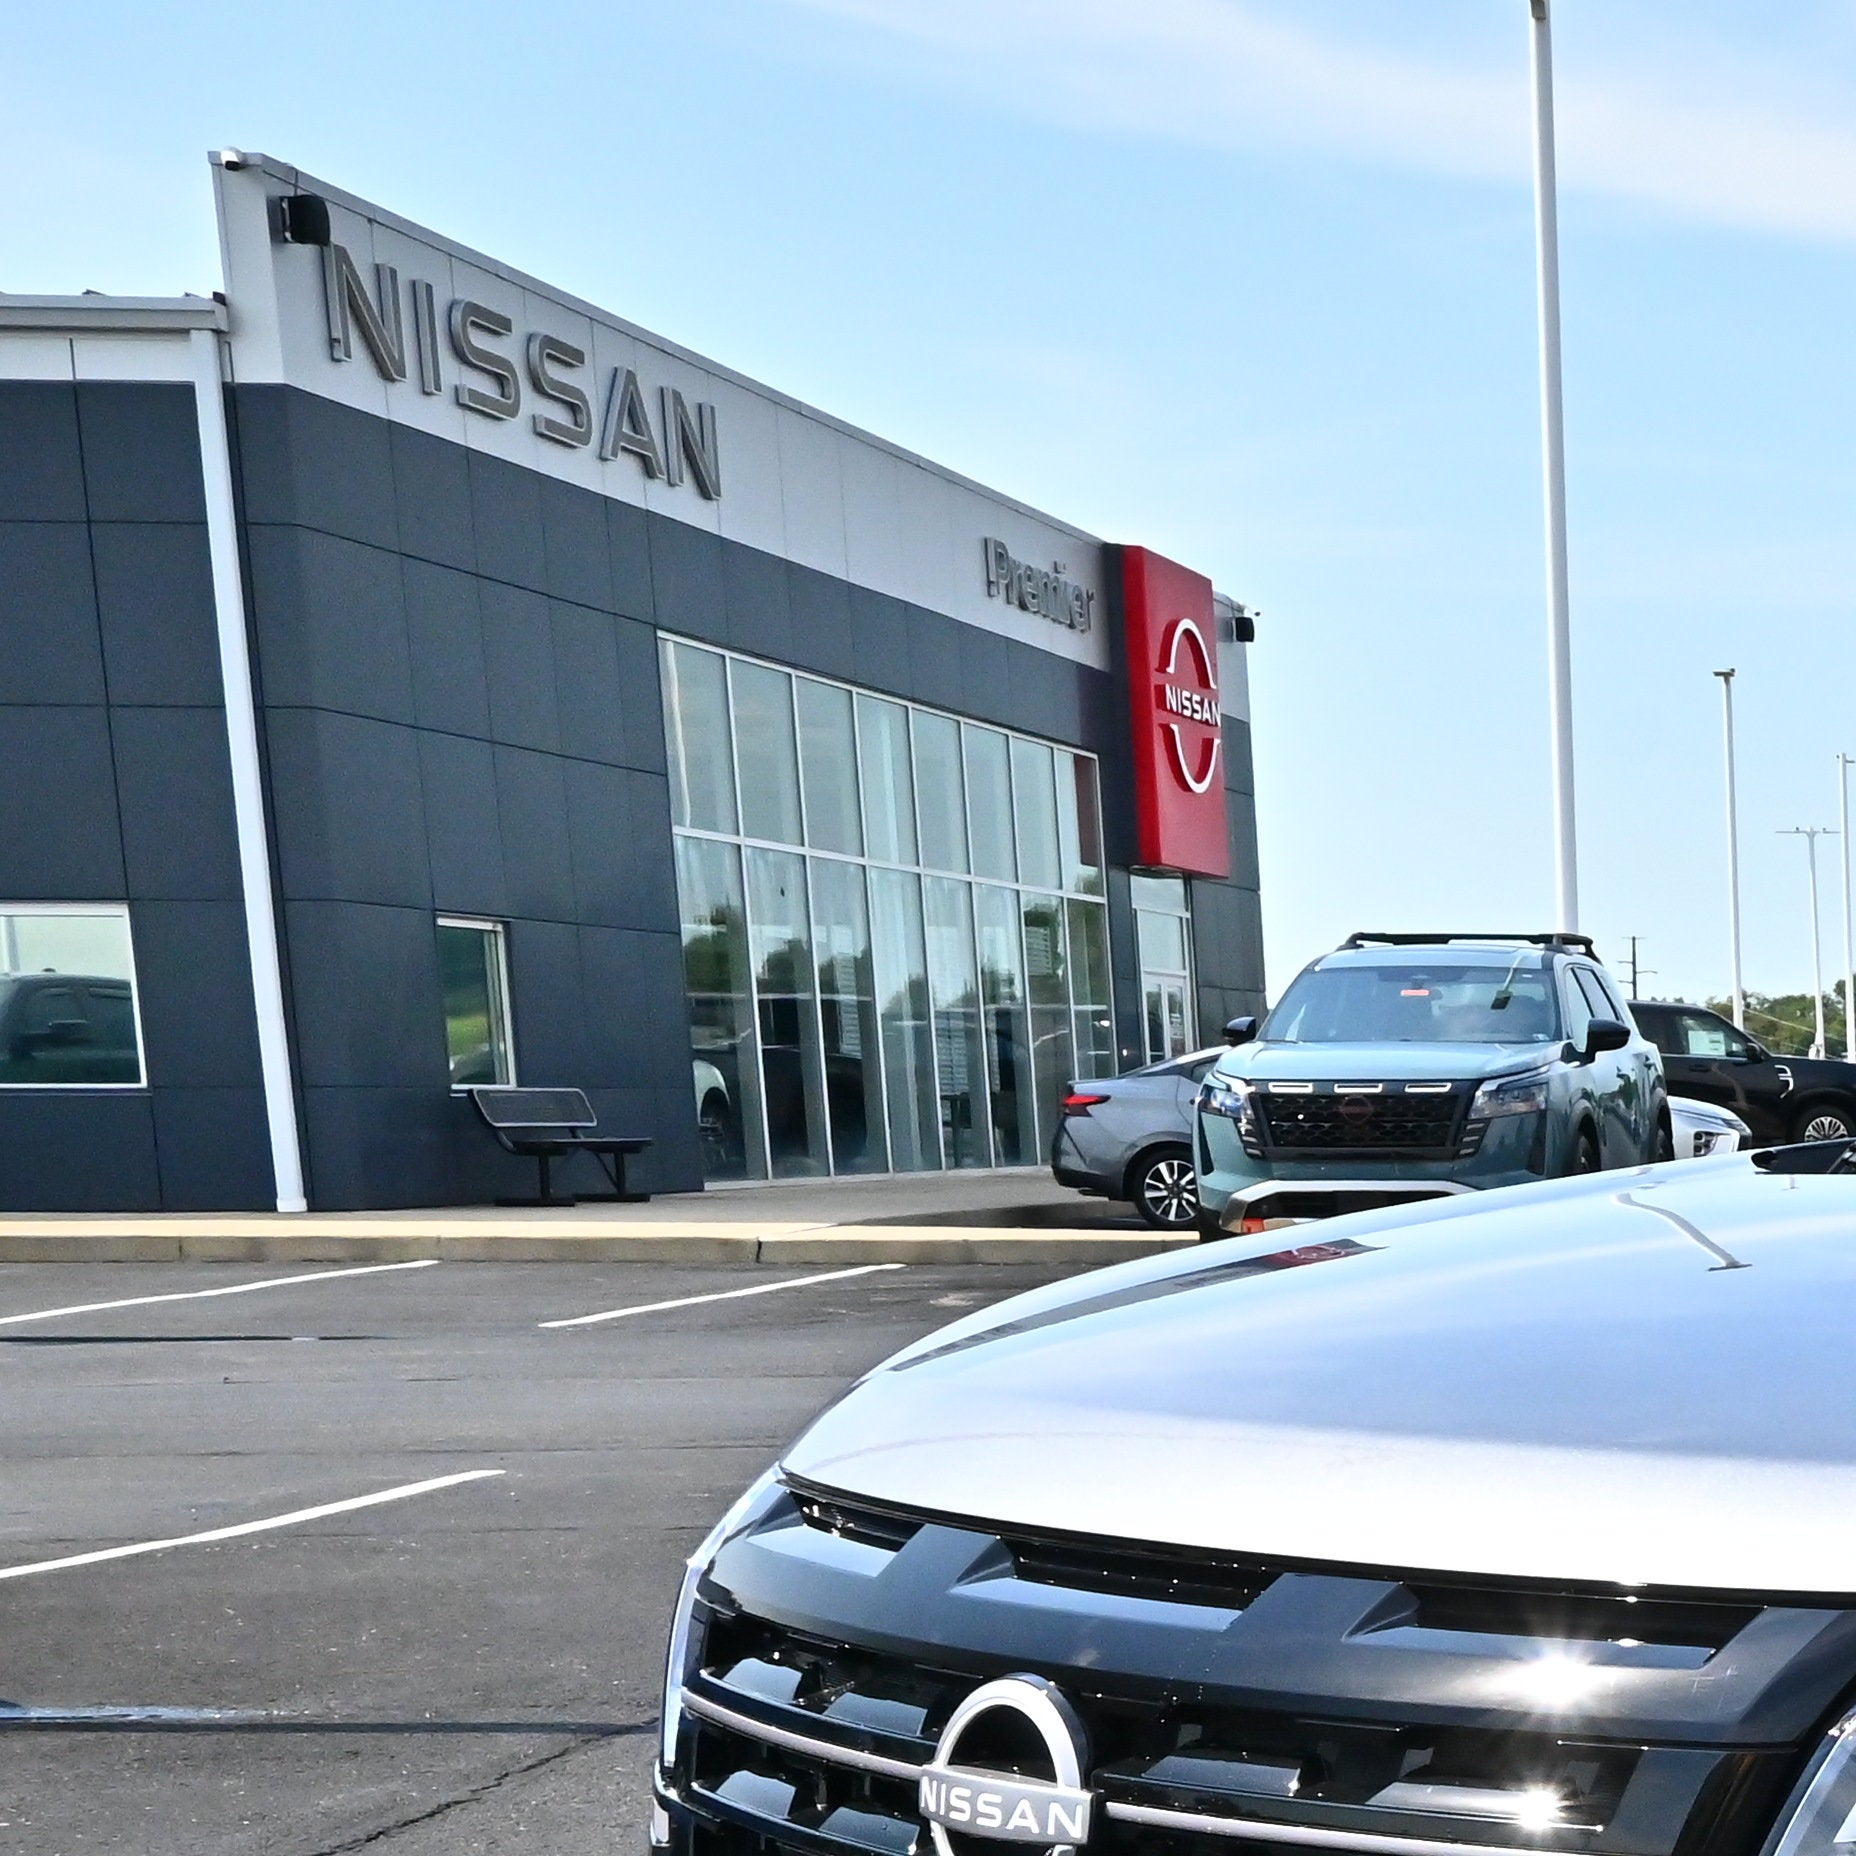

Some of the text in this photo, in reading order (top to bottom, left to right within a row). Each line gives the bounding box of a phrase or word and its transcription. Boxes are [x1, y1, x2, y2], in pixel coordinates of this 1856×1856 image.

[322, 242, 722, 501] NISSAN
[983, 537, 1095, 634] Premier
[1165, 682, 1221, 728] NISSAN
[919, 1775, 1083, 1839] NISSAN
